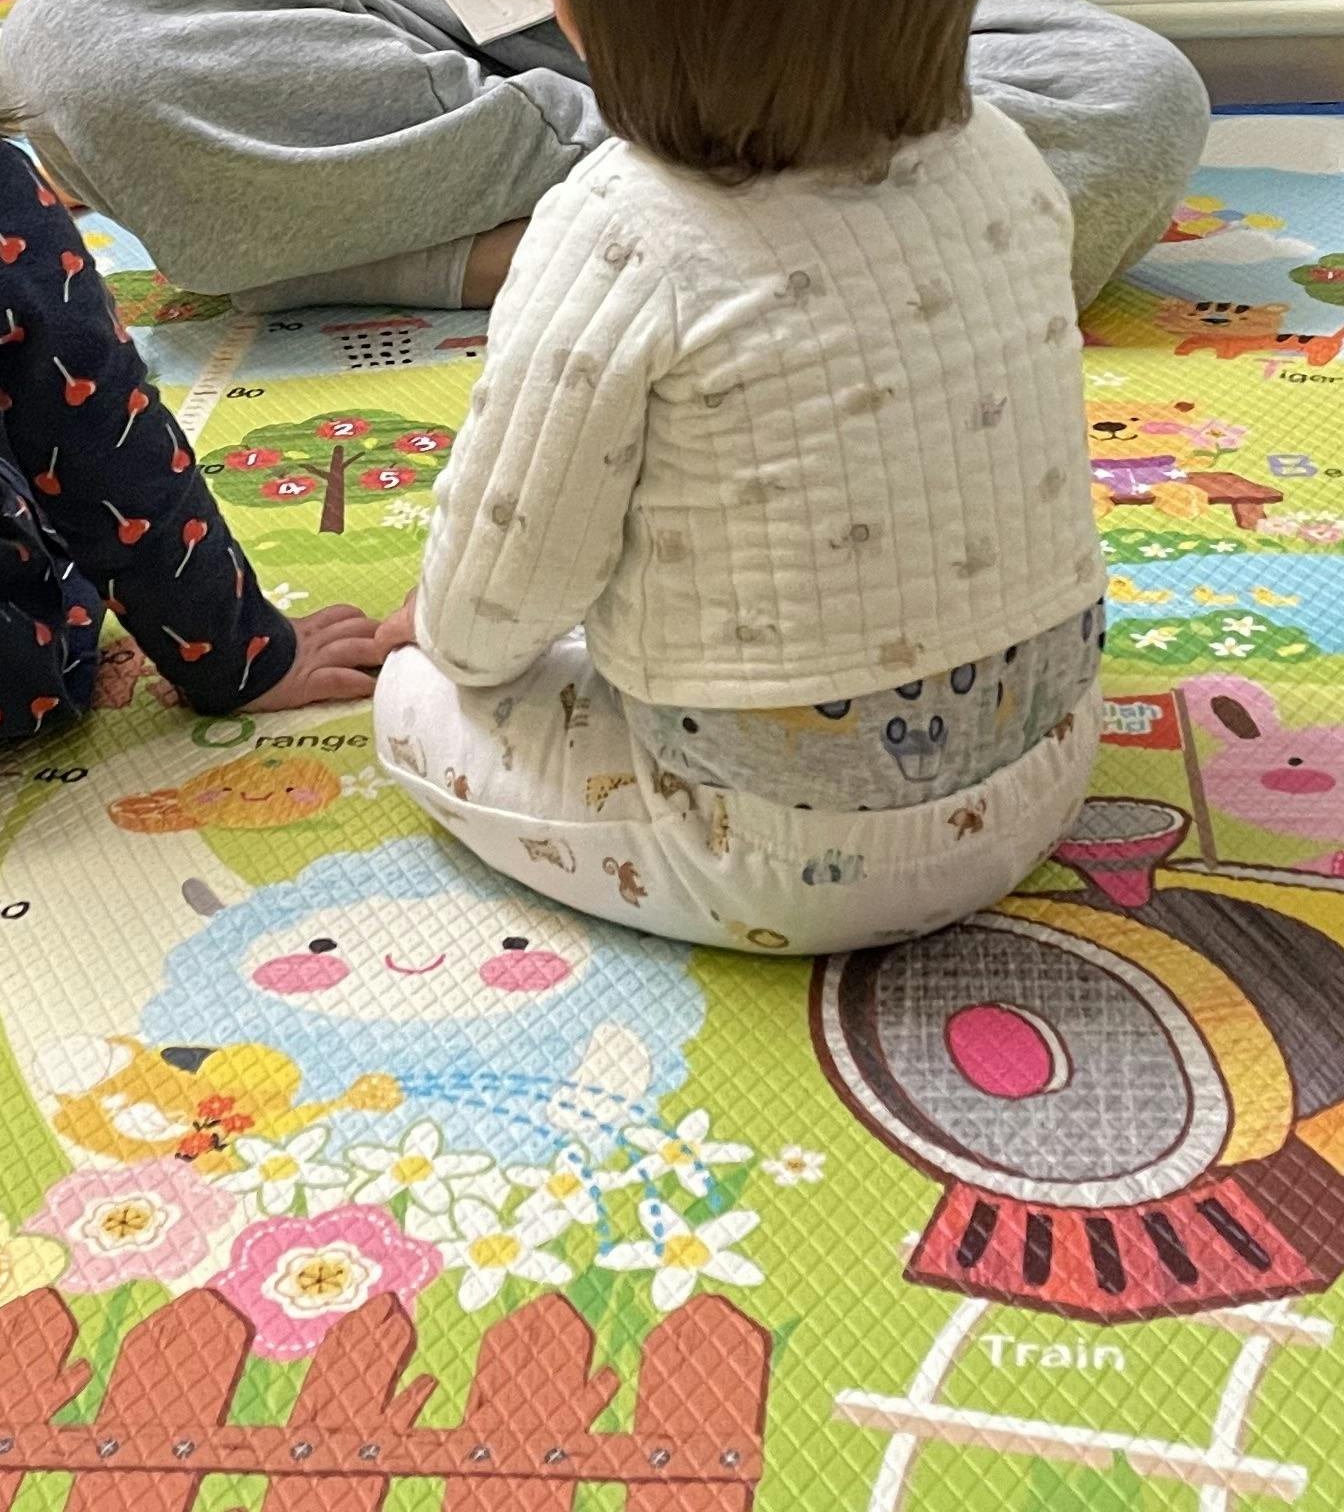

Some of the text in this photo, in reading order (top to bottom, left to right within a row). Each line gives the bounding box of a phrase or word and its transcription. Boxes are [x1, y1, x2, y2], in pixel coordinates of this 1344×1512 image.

[226, 387, 265, 399] 80
[333, 422, 355, 436] 2
[411, 435, 438, 452] 3
[246, 453, 257, 466] 1
[279, 481, 307, 495] 4
[378, 471, 400, 489] 5
[191, 715, 370, 752] Orange
[33, 767, 89, 783] 40
[978, 1334, 1126, 1372] Train
